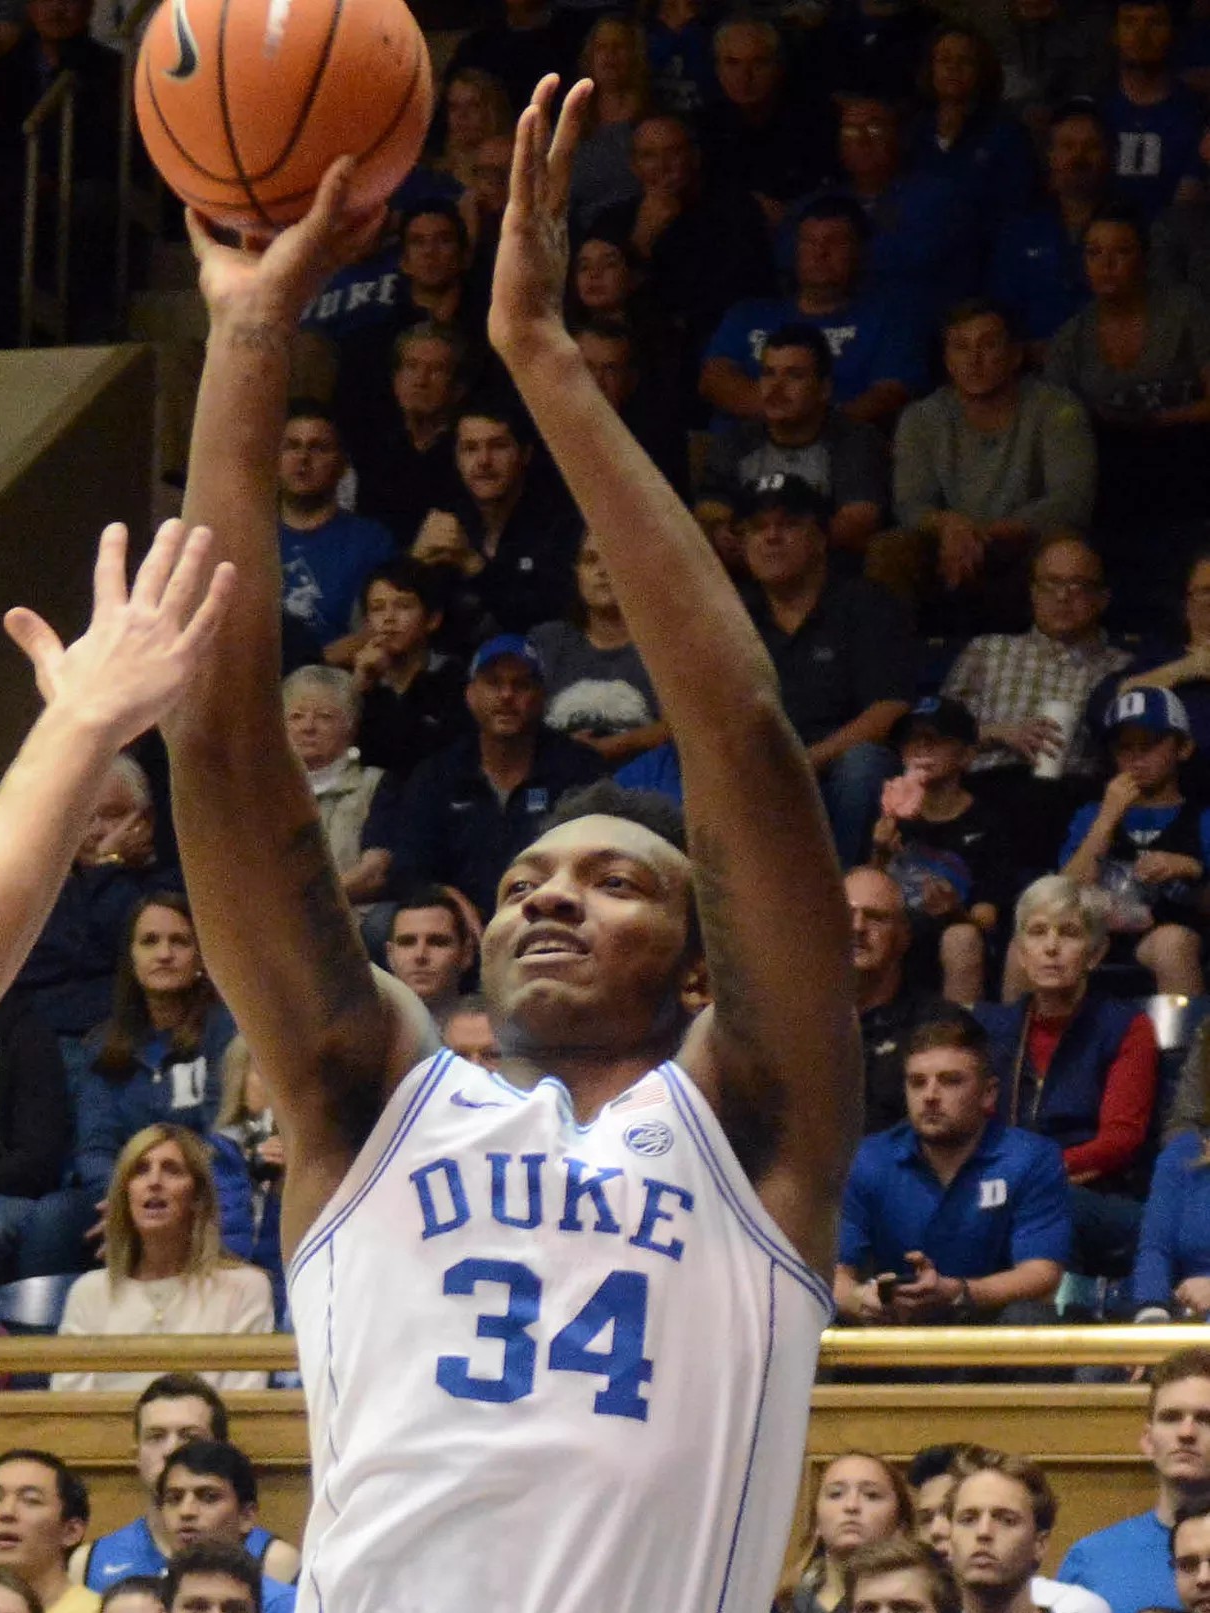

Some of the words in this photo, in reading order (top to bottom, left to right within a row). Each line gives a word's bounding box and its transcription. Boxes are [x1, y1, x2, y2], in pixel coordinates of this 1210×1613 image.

[299, 272, 398, 322] UKE
[409, 1153, 694, 1262] DUKE
[436, 1258, 654, 1422] 34
